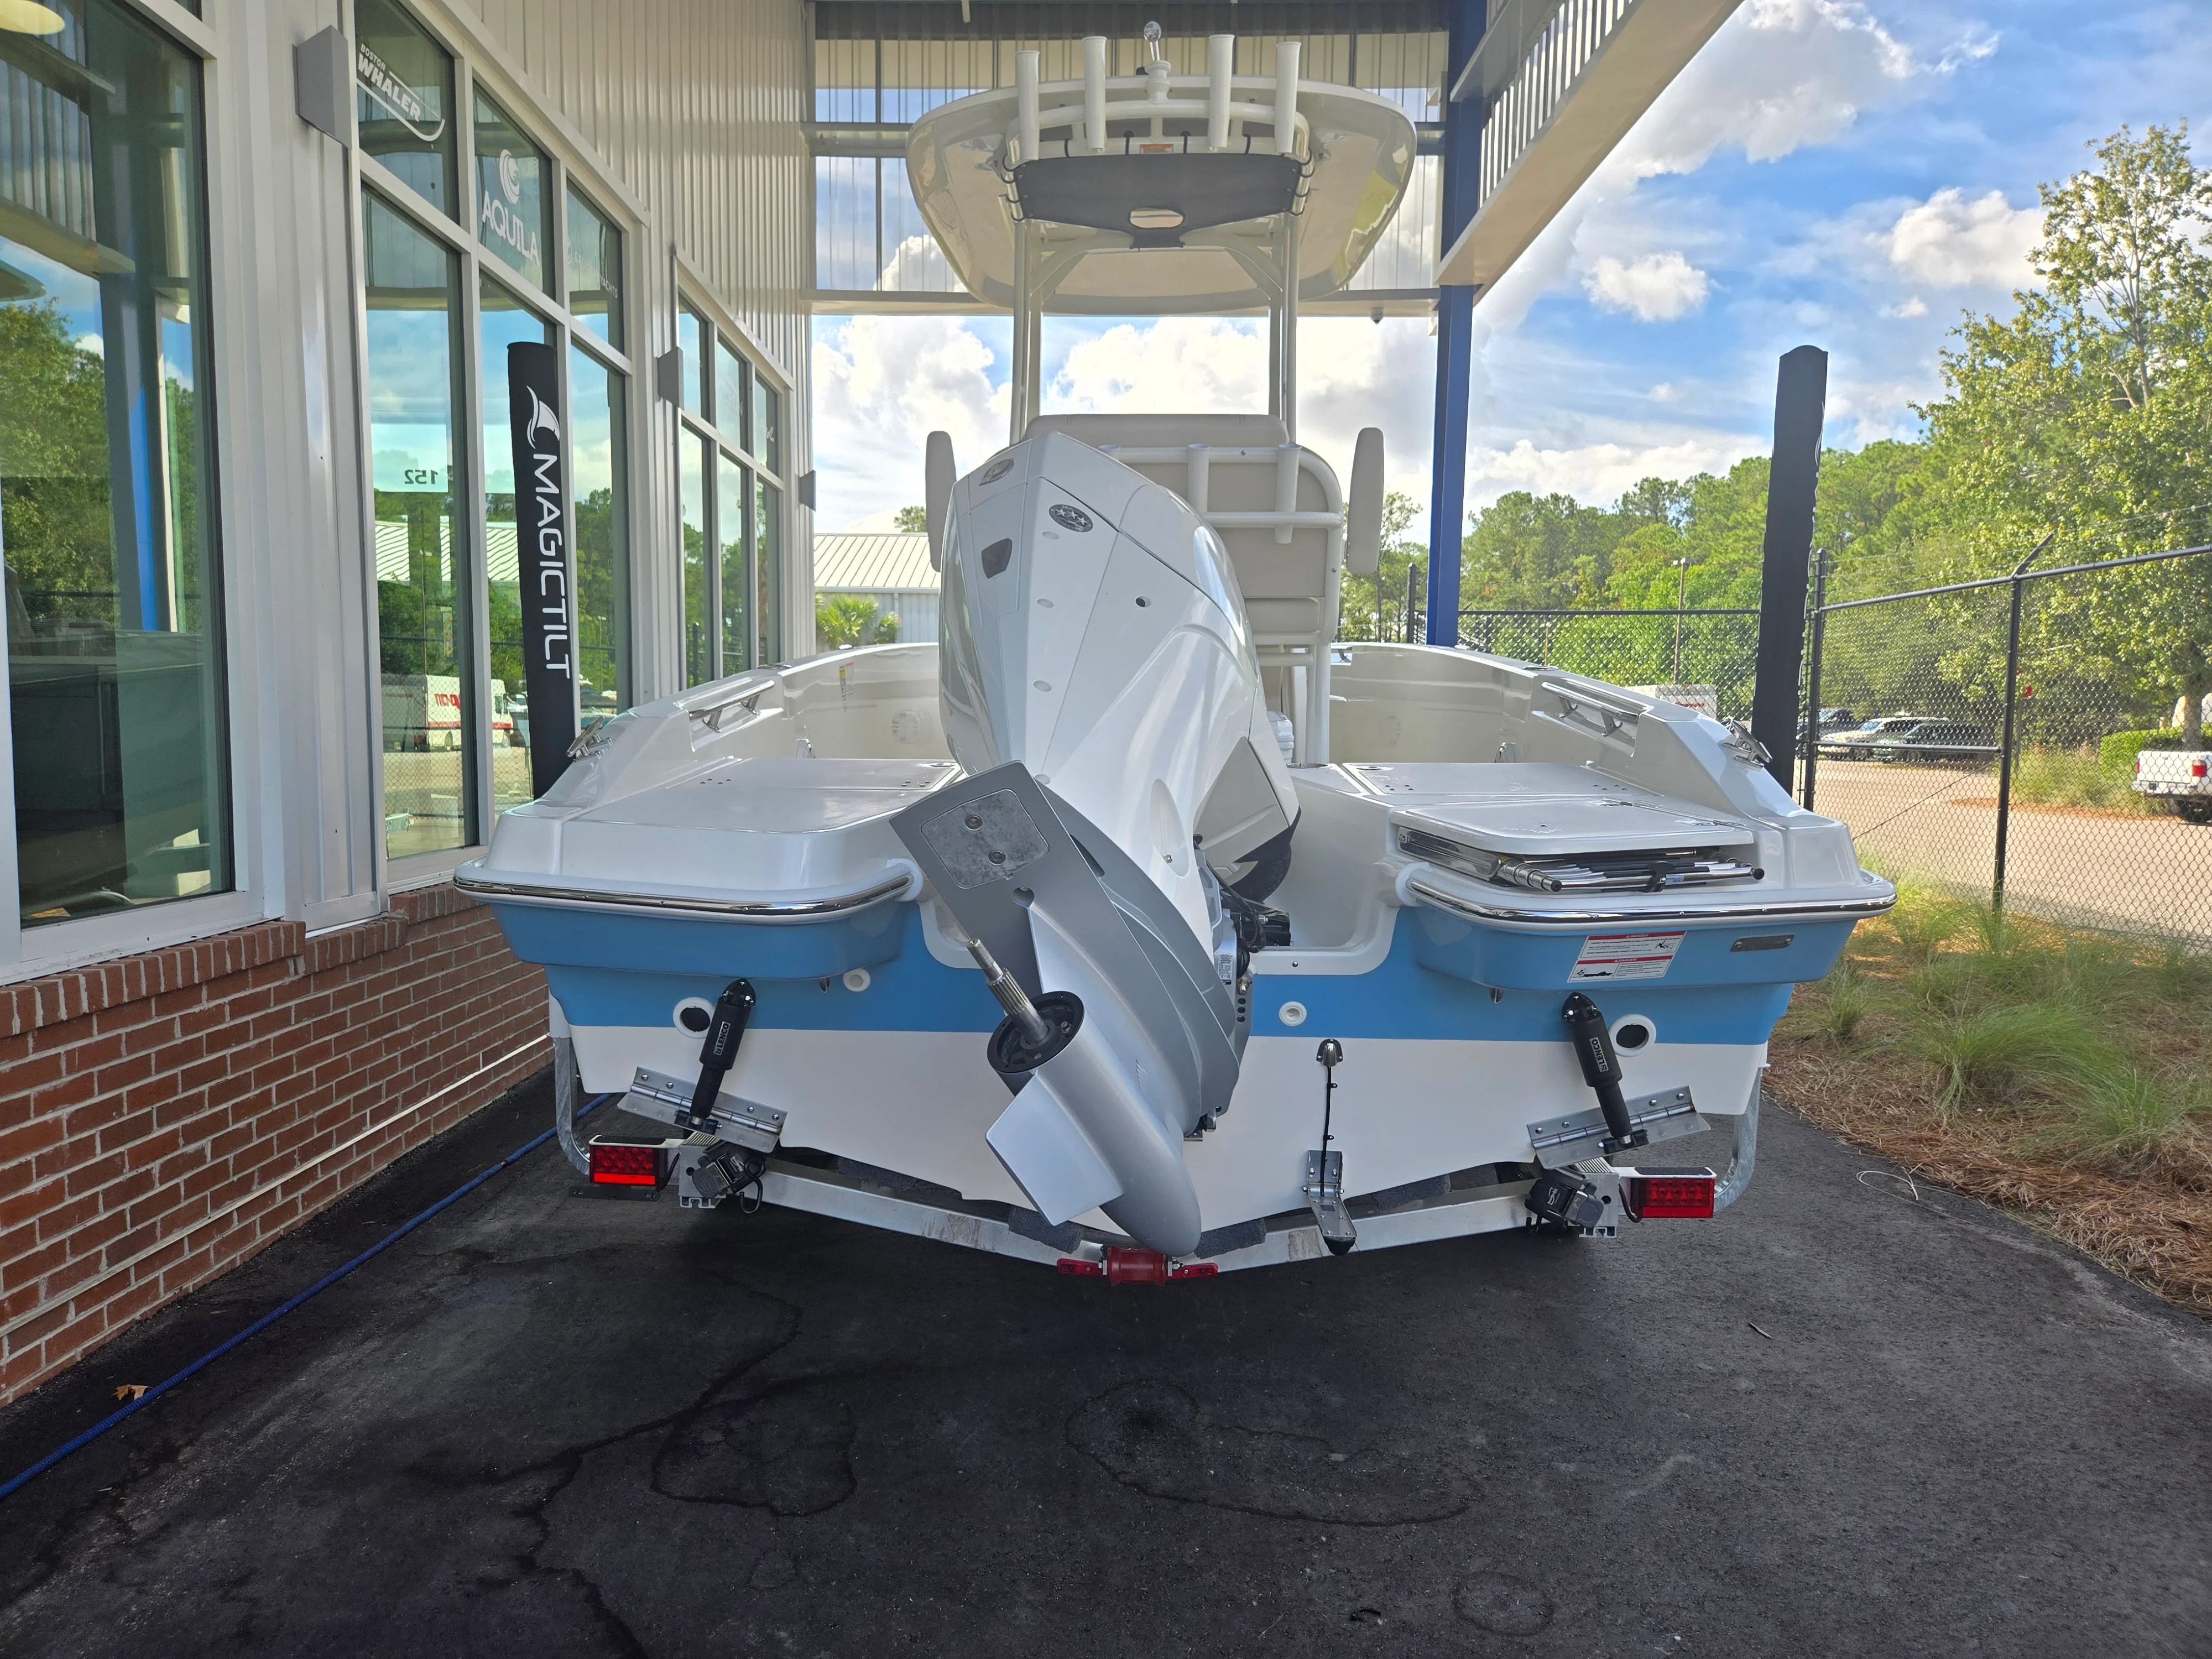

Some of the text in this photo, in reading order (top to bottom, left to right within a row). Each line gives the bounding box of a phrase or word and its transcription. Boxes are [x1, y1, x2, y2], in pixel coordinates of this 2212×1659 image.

[361, 43, 386, 71] BOSTON
[358, 53, 421, 123] WHALER
[482, 190, 540, 268] AQUILA
[533, 453, 570, 679] MAGICTILT
[717, 1023, 729, 1048] LENCO
[1592, 1039, 1605, 1065] LENCO
